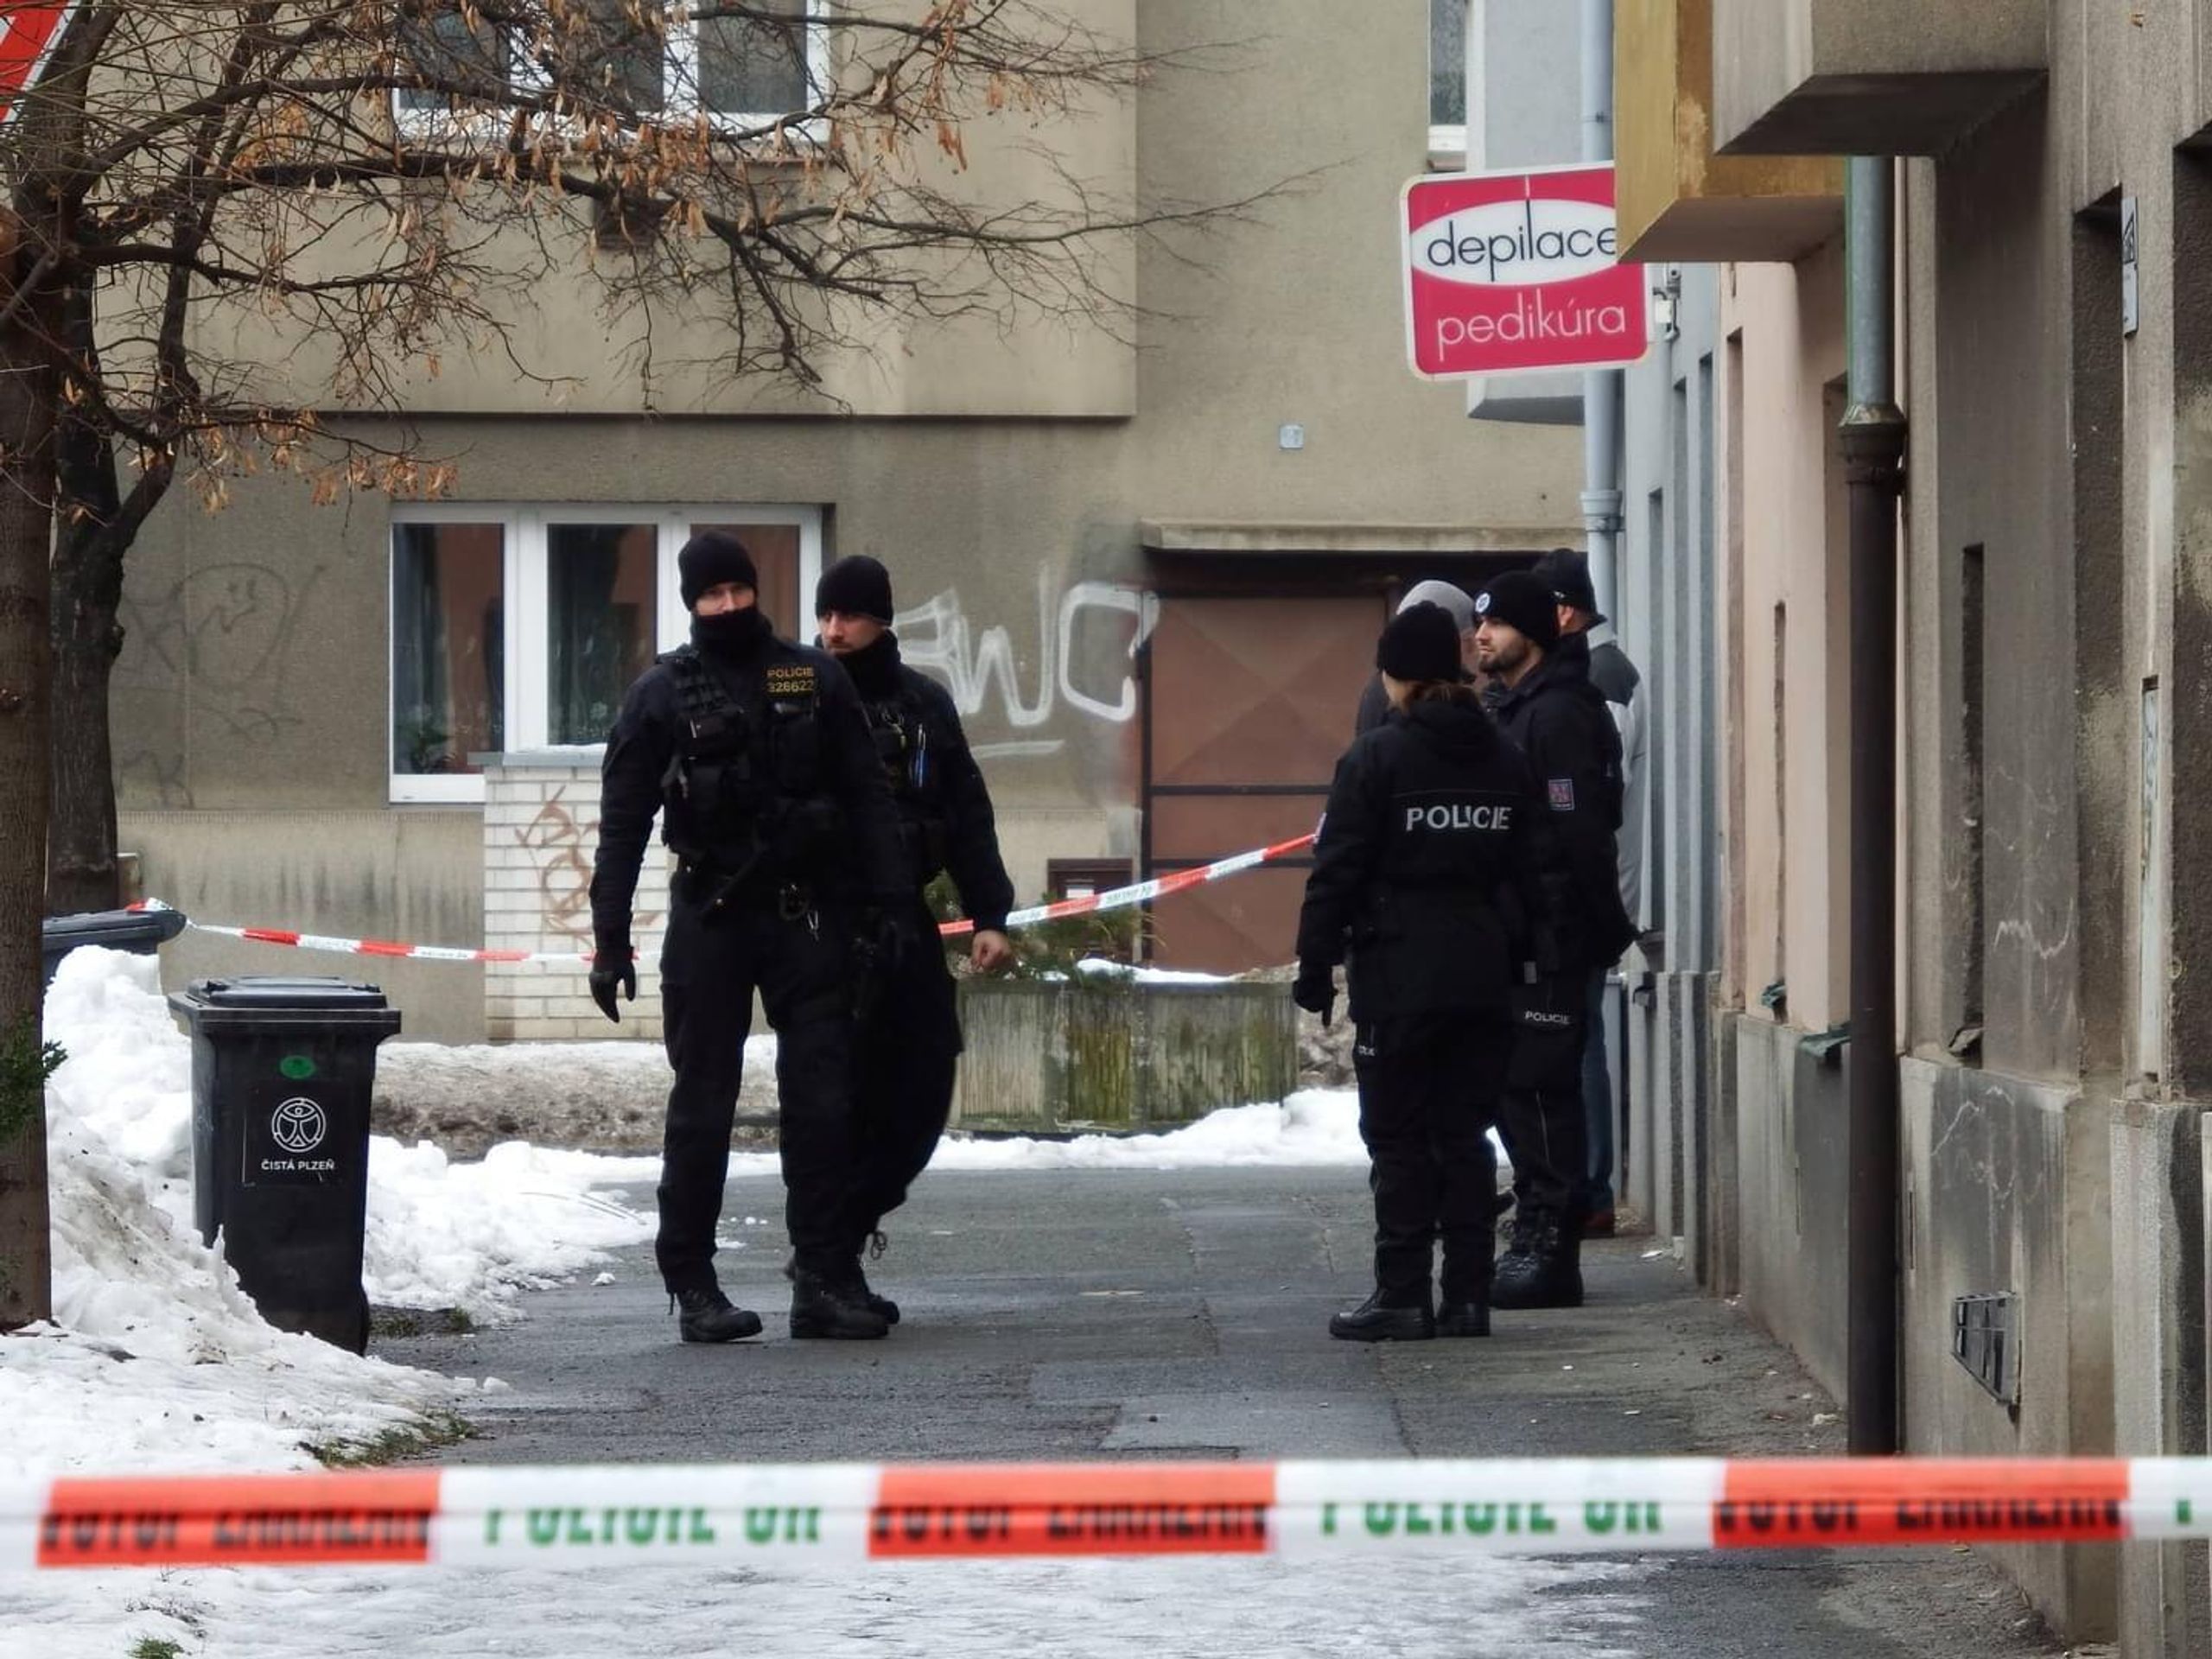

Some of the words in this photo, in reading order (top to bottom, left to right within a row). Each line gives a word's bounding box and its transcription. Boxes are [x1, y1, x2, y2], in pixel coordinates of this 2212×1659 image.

[1427, 175, 1617, 283] depilace
[1436, 288, 1626, 363] pedikúra
[766, 666, 815, 678] POLICIE
[1406, 804, 1512, 831] POLICIE
[261, 1158, 296, 1171] ČISTÁ
[298, 1158, 335, 1171] PLZEŇ
